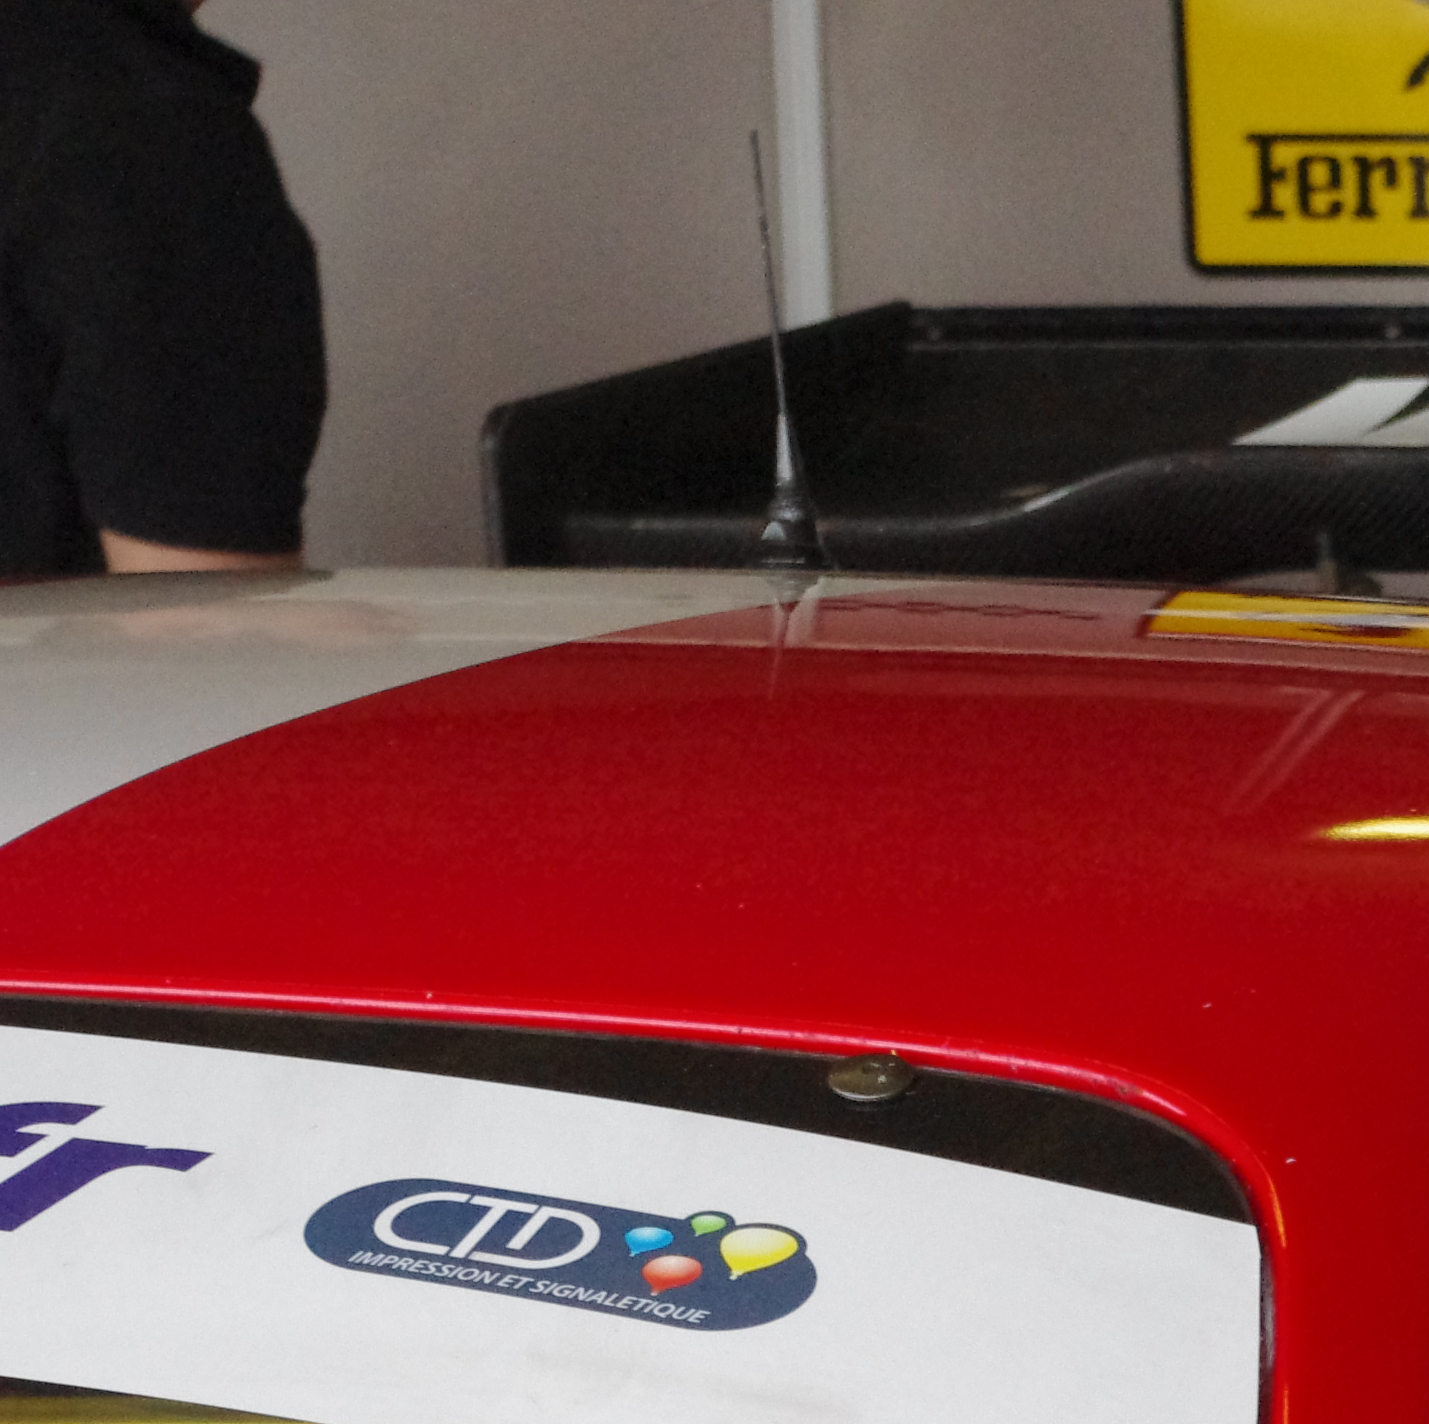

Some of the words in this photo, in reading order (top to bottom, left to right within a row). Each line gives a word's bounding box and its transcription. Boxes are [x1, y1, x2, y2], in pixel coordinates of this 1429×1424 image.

[373, 1191, 601, 1270] CTD
[349, 1250, 499, 1286] IMPRESSION
[495, 1274, 537, 1290] ET
[528, 1280, 711, 1324] SIGNALETIQUE
